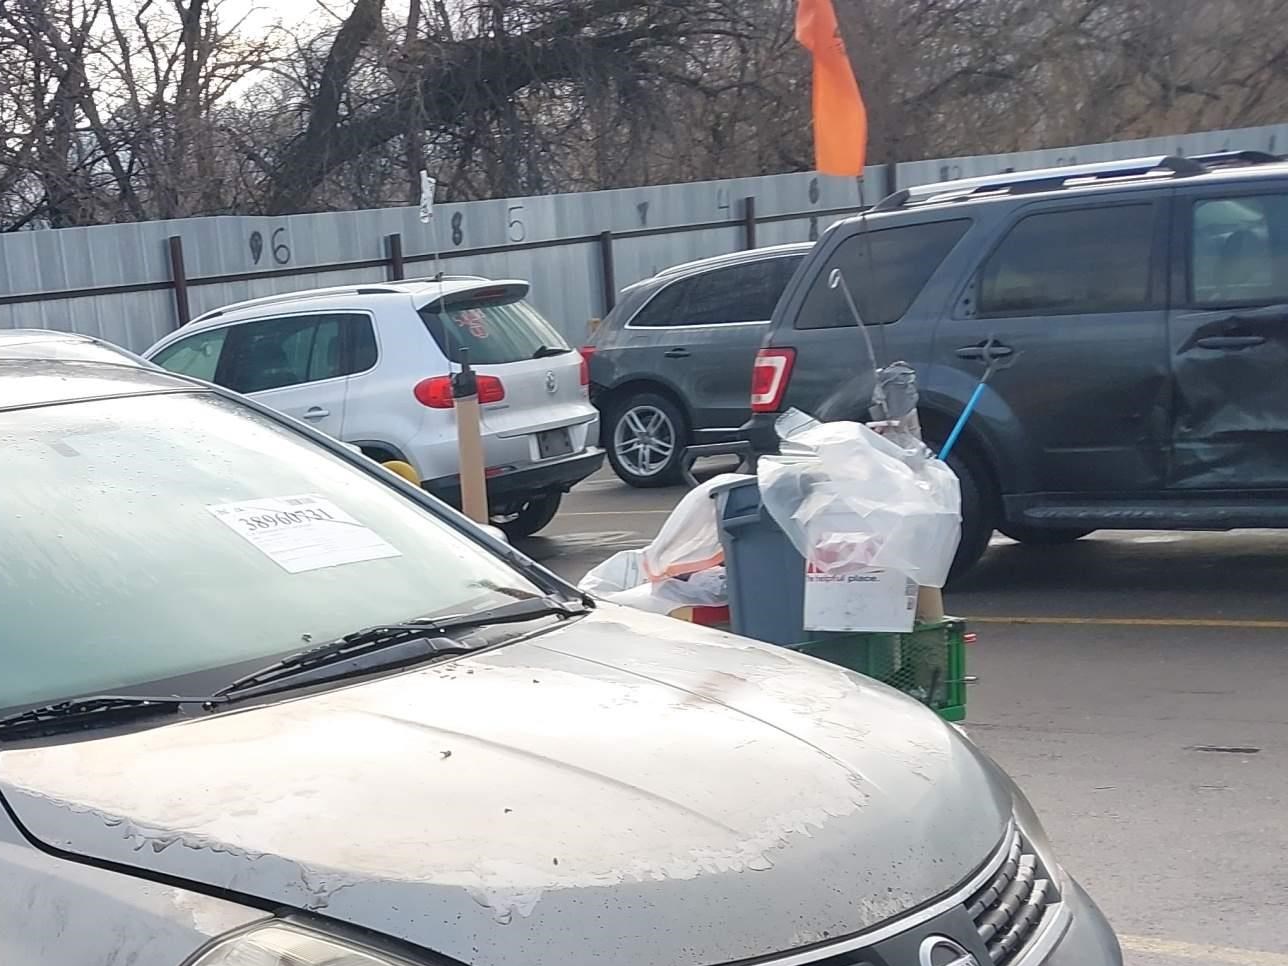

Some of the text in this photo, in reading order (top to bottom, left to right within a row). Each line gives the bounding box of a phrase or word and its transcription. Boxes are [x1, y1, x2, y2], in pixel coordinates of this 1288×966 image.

[508, 206, 525, 242] 5
[272, 227, 291, 264] 6
[238, 507, 334, 532] 38960731
